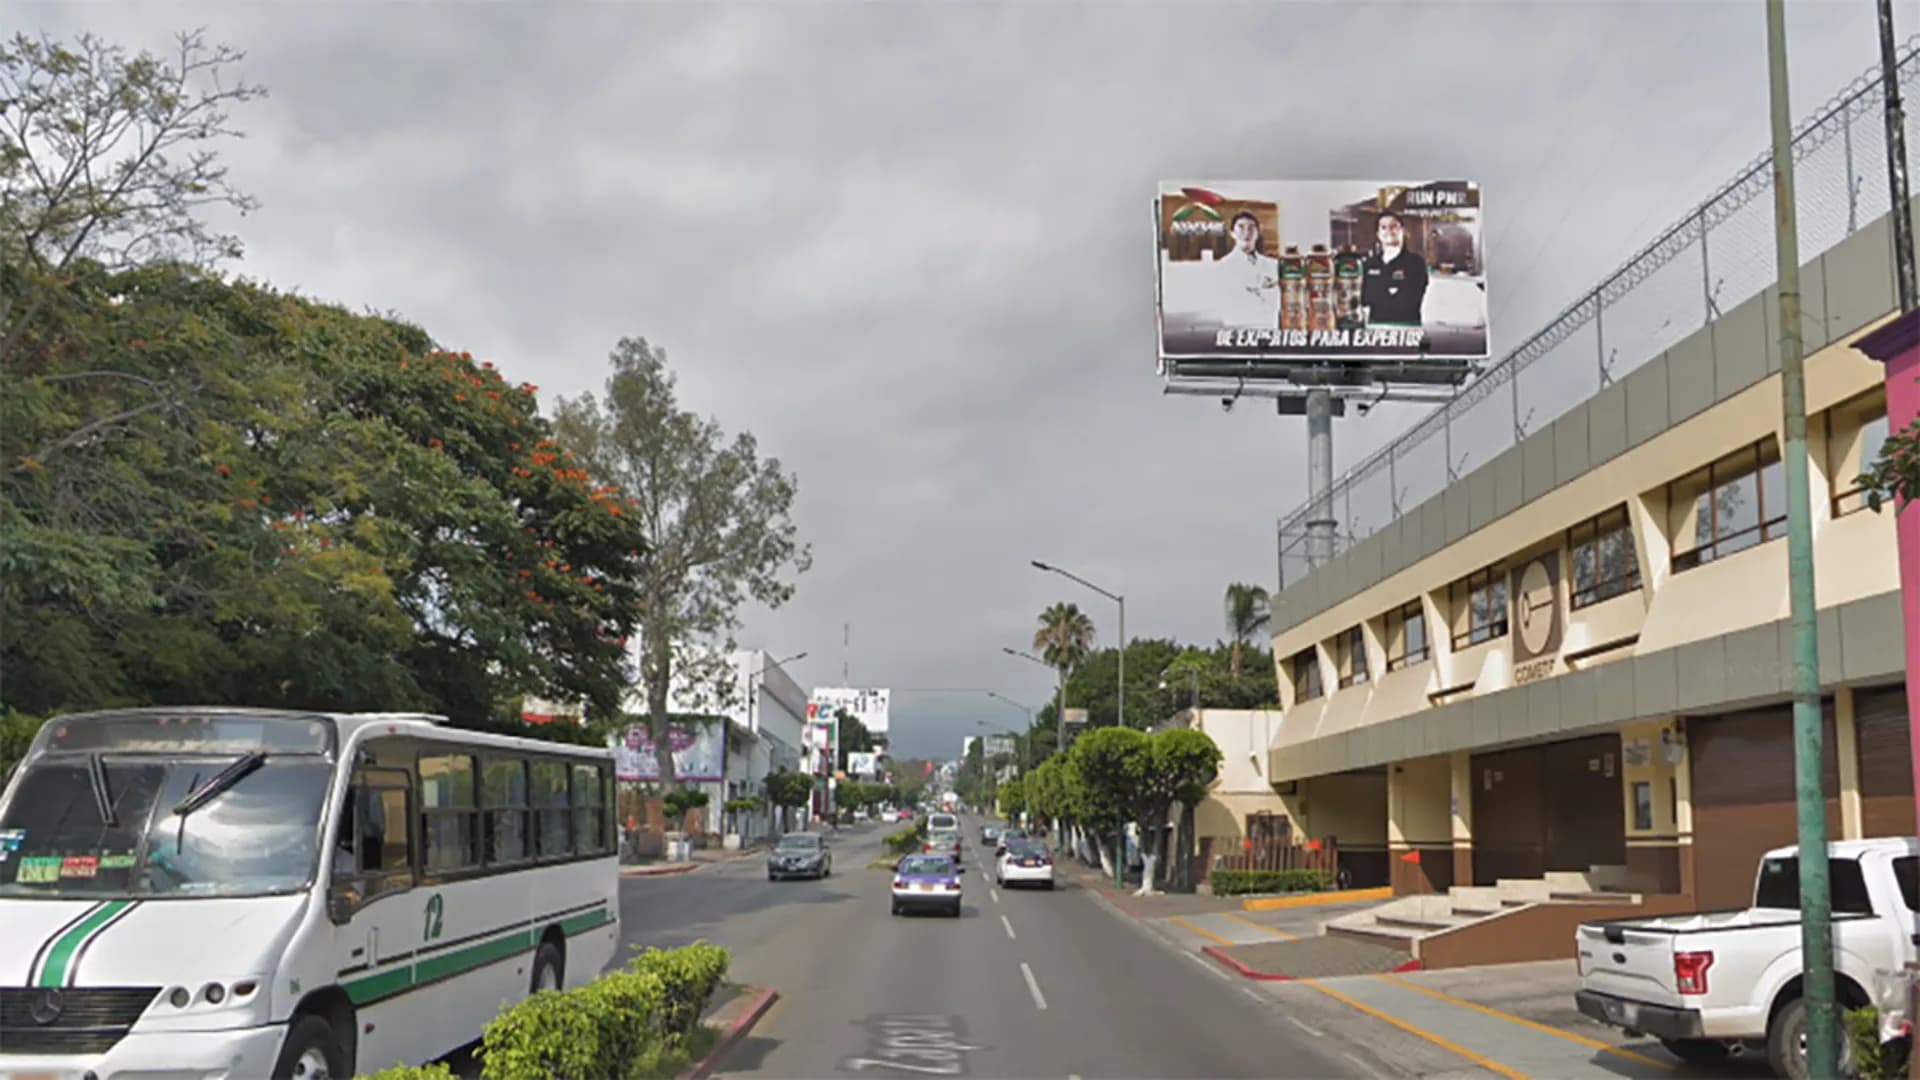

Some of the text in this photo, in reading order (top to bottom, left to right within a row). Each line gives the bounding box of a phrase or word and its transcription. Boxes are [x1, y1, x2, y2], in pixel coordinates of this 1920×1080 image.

[1216, 329, 1232, 347] DE
[1310, 329, 1350, 347] PARA
[1353, 329, 1424, 347] EXPERTOS
[424, 893, 443, 942] 12
